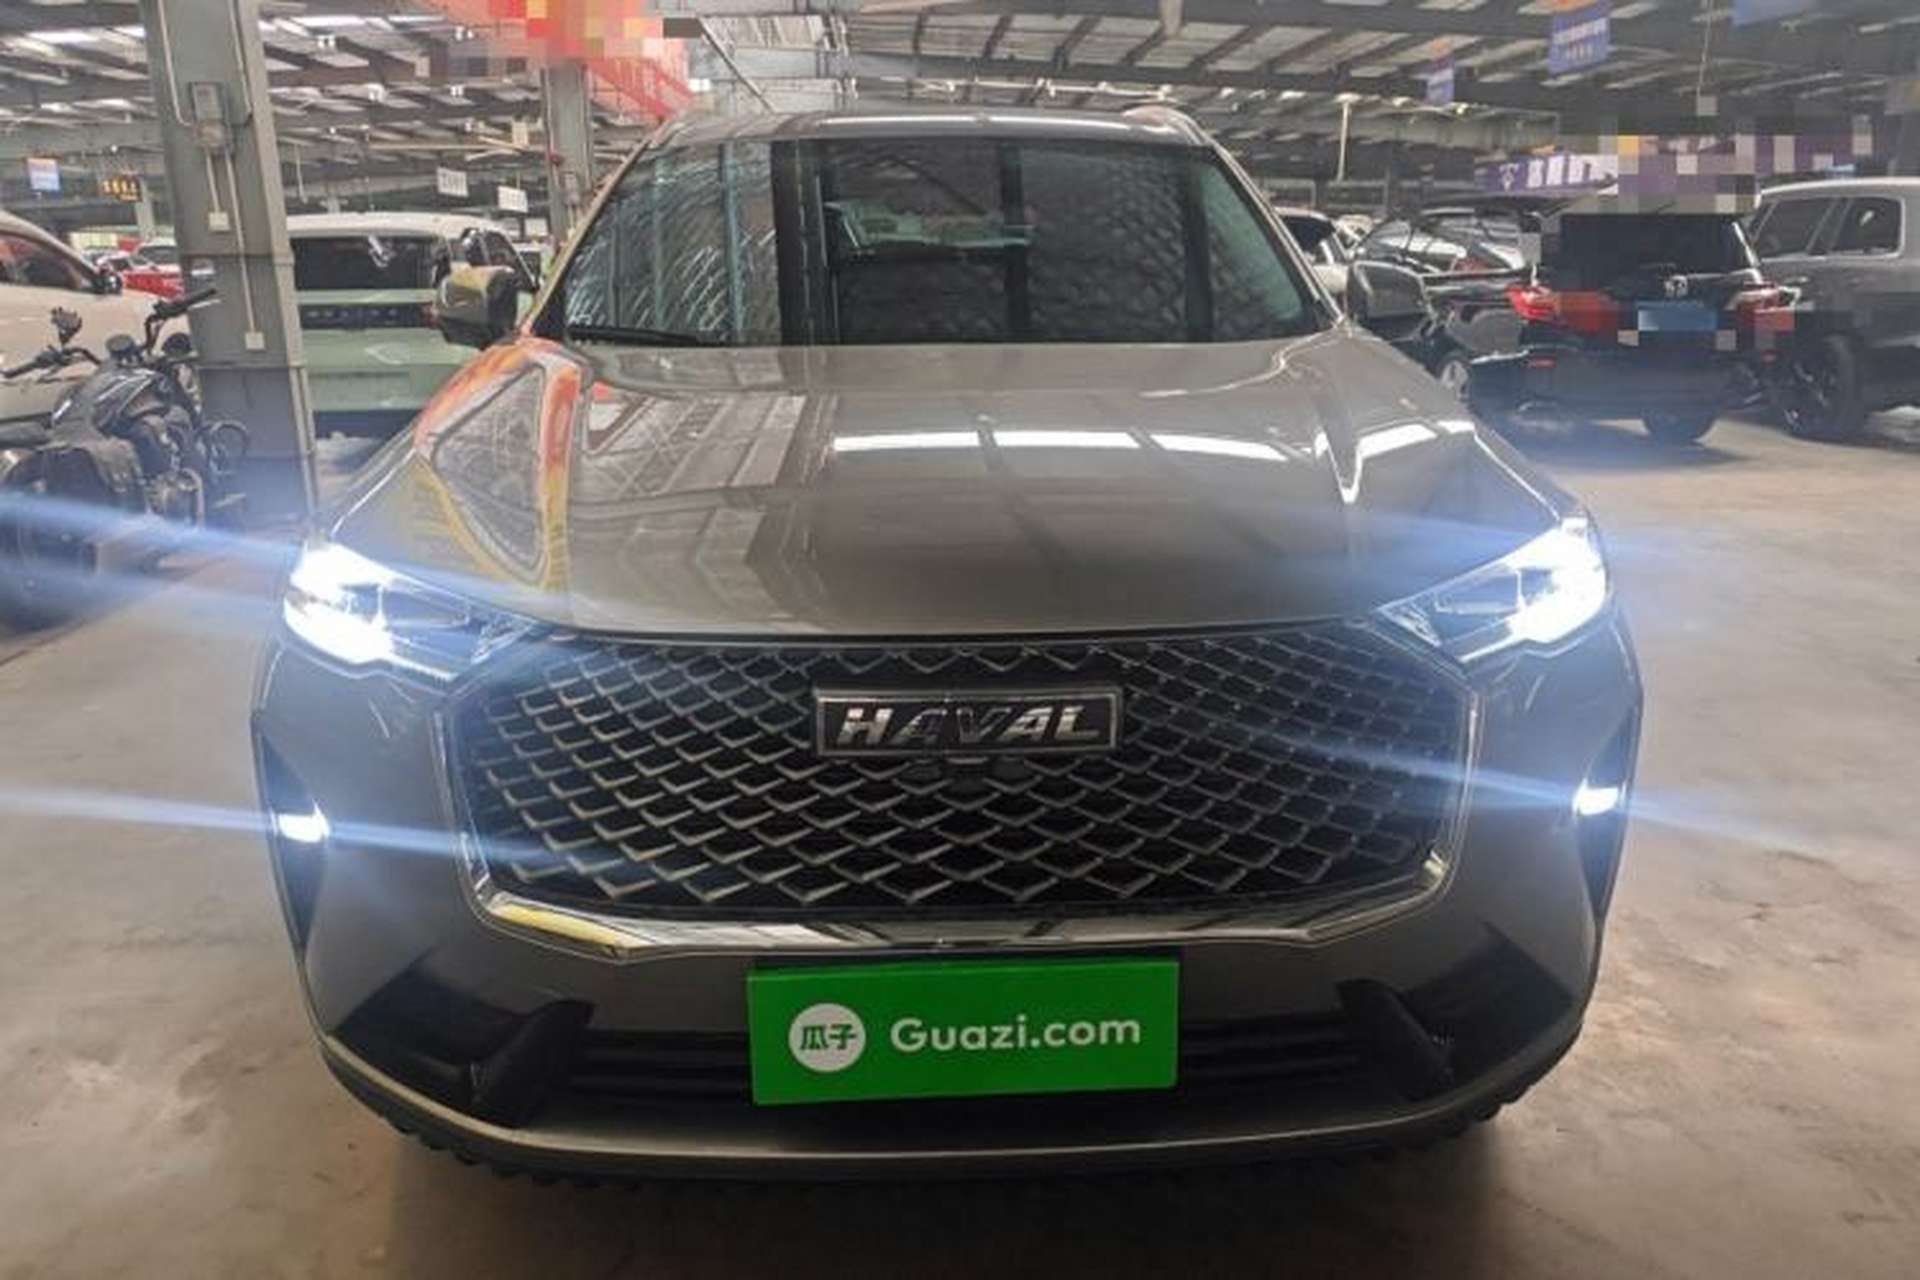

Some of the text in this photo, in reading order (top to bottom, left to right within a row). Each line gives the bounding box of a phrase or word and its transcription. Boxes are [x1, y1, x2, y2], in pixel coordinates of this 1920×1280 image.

[836, 705, 1100, 746] HAVAL
[800, 1023, 858, 1051] 瓜子
[890, 1014, 1141, 1052] Guazi.com
